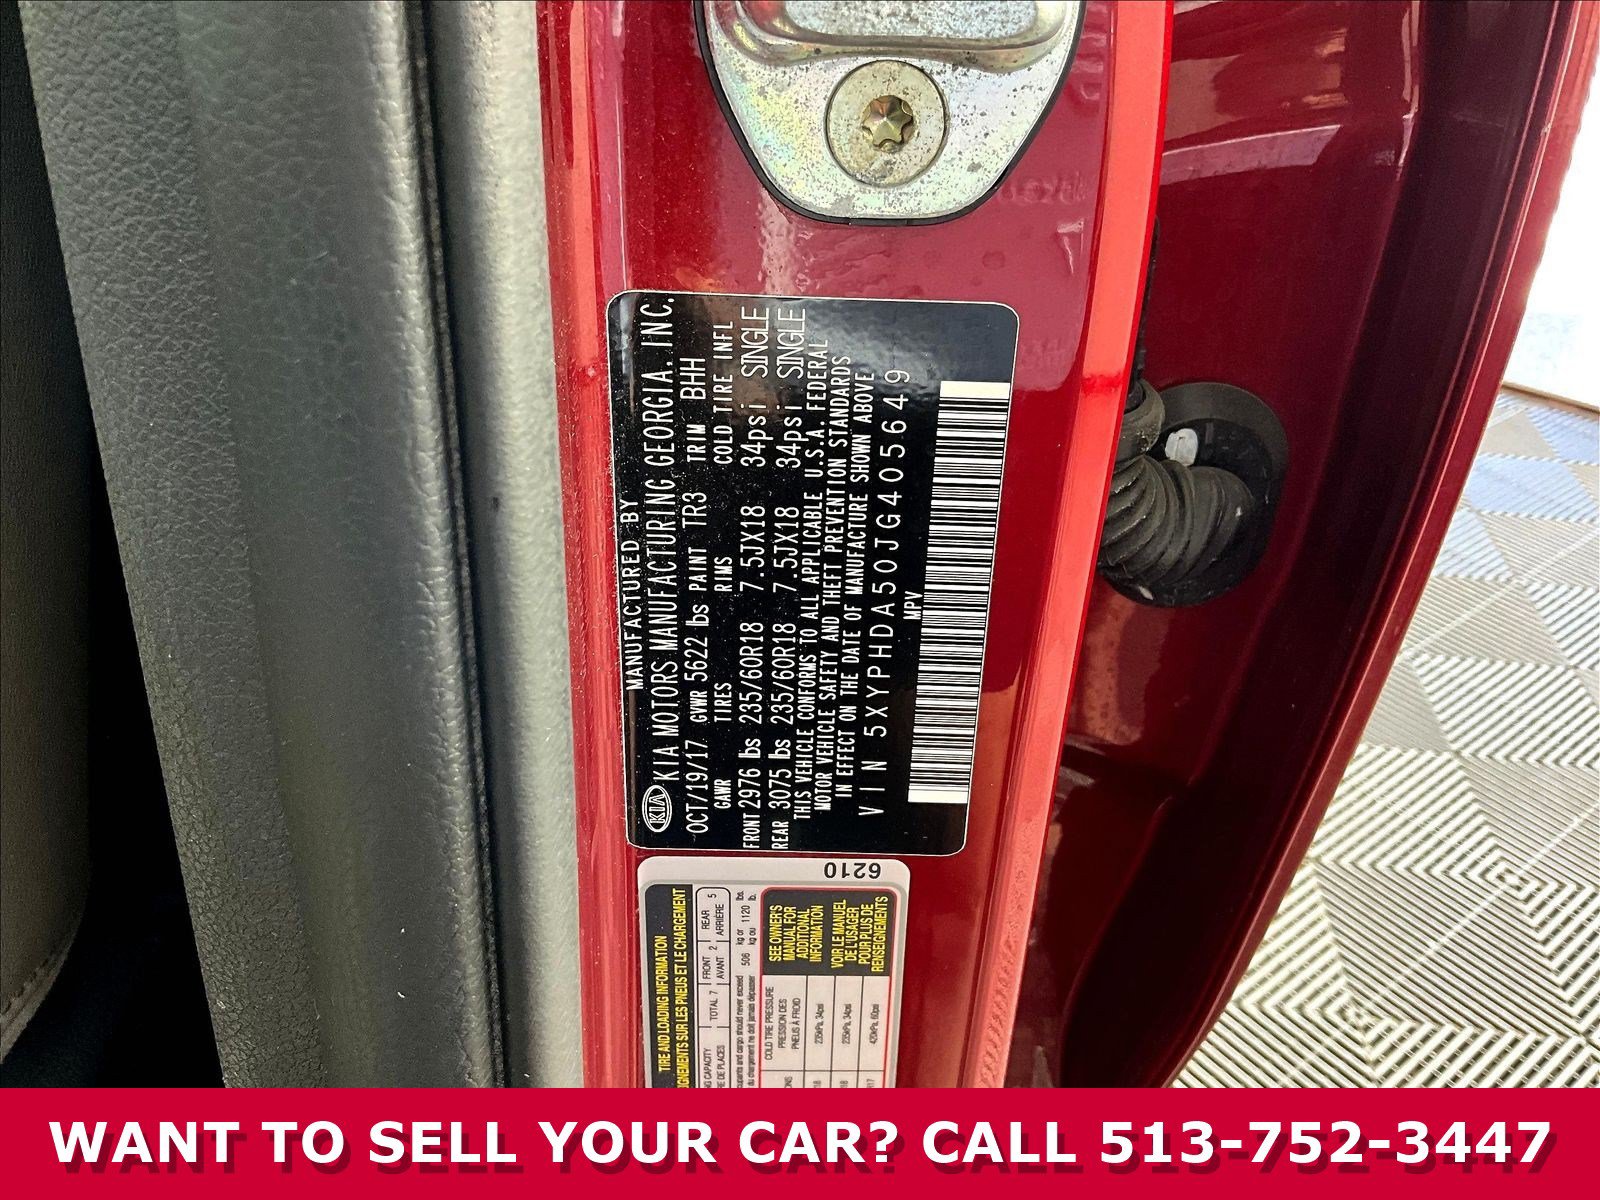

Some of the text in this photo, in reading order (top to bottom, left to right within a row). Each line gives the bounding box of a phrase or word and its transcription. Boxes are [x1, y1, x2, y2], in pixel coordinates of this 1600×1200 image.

[640, 299, 674, 346] INC.
[645, 479, 678, 650] MANUFACTURING
[713, 322, 733, 809] GAWR TIRES RIMS COLD TIRE INFL
[738, 307, 772, 848] FRONT 2976 lbs 235/60R18 7.5JX18 34psi SINGLE
[768, 308, 808, 849] REAR 3075 lbs 235/60R18 7.5JX18 34psi SINGLE
[794, 340, 828, 819] THIS VEHICLE CONFORMS TO ALL APPLICABLE U.S.A. FEDERAL
[815, 356, 850, 811] MOTOR VEHICLE SAFETY AND THEFT PREVENTION STANDARDS
[836, 373, 875, 797] IN EFFECT ON THE DATE OF MANUFACTURE SHOWN ABOVE
[620, 499, 643, 690] MANUFACTURED BY
[680, 358, 709, 833] OCT/19/17 GVWR 5622 lbs PAINT TR3 TRIM BHH
[859, 370, 910, 815] VIN 5XYPHDA50JG405649
[903, 591, 922, 619] MPV
[650, 661, 679, 736] MOTORS
[653, 746, 679, 780] KIA
[824, 862, 880, 878] 6210
[672, 888, 686, 949] CHARGEMENT
[701, 910, 709, 929] REAR
[714, 904, 724, 936] ARRIÈRE
[741, 905, 750, 922] 1120
[769, 905, 782, 961] SEE OWNER'S
[783, 907, 797, 960] MANUAL FOR
[797, 909, 810, 958] ADDITIONAL
[810, 906, 824, 962] INFORMATION
[831, 900, 846, 968] VOIR LE MANUEL
[845, 907, 859, 961] DE L'USAGER
[859, 904, 873, 964] POUR PLUS DE
[872, 897, 888, 972] RENSEIGNEMENTS
[674, 951, 687, 962] LE
[674, 965, 687, 975] ET
[702, 956, 711, 979] FRONT
[716, 956, 724, 979] AVANT
[741, 953, 750, 966] 506
[655, 936, 671, 1071] TIRE AND LOADING INFORMATION
[674, 977, 688, 1005] PNEUS
[675, 1007, 688, 1022] LES
[710, 999, 718, 1020] TOTAL
[792, 998, 800, 1019] FROID
[676, 1024, 688, 1041] SUR
[765, 987, 774, 1060] COLD TIRE PRESSURE
[778, 999, 787, 1048] PRESSION DES
[791, 1027, 799, 1049] PNEUS
[704, 1048, 712, 1079] CAPACITY
[717, 1045, 725, 1069] PLACES
[717, 1070, 725, 1079] DE
